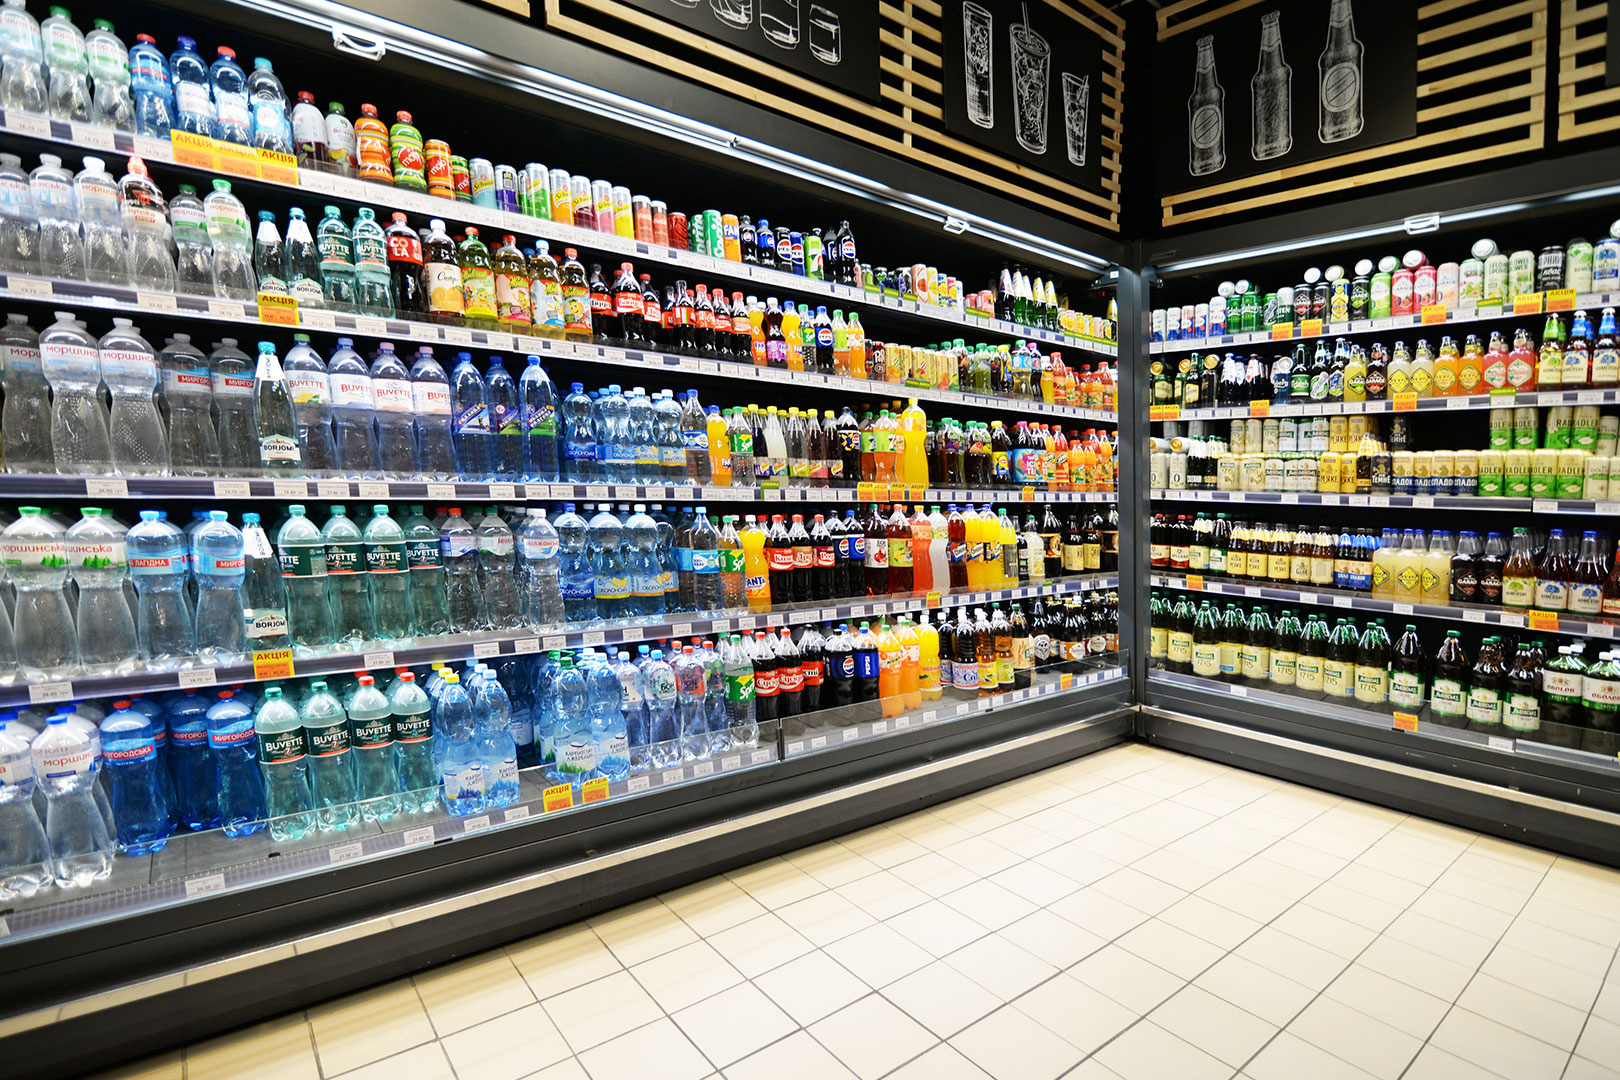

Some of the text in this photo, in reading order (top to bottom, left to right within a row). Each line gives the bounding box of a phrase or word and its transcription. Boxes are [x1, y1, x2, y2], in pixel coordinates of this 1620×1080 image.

[176, 133, 213, 149] АКЦІЯ
[262, 151, 294, 164] АКЦІЯ
[430, 158, 447, 175] mojo
[390, 237, 408, 249] CO
[395, 247, 410, 258] LA
[262, 295, 294, 306] АКЦІЯ
[289, 379, 324, 389] BUVETTE
[376, 389, 411, 400] BUVETTE
[1372, 475, 1391, 485] ТЕМНЕ
[366, 551, 401, 561] BUVETTE
[135, 559, 167, 568] ЛАГІДНА
[1532, 611, 1556, 619] АКЦІЯ
[256, 651, 289, 661] АКЦІЯ
[356, 724, 392, 737] BUVETTE
[396, 719, 431, 731] BUVETTE
[313, 730, 348, 746] BUVETTE
[265, 736, 304, 752] BUVETTE
[545, 785, 569, 797] АКЦІЯ
